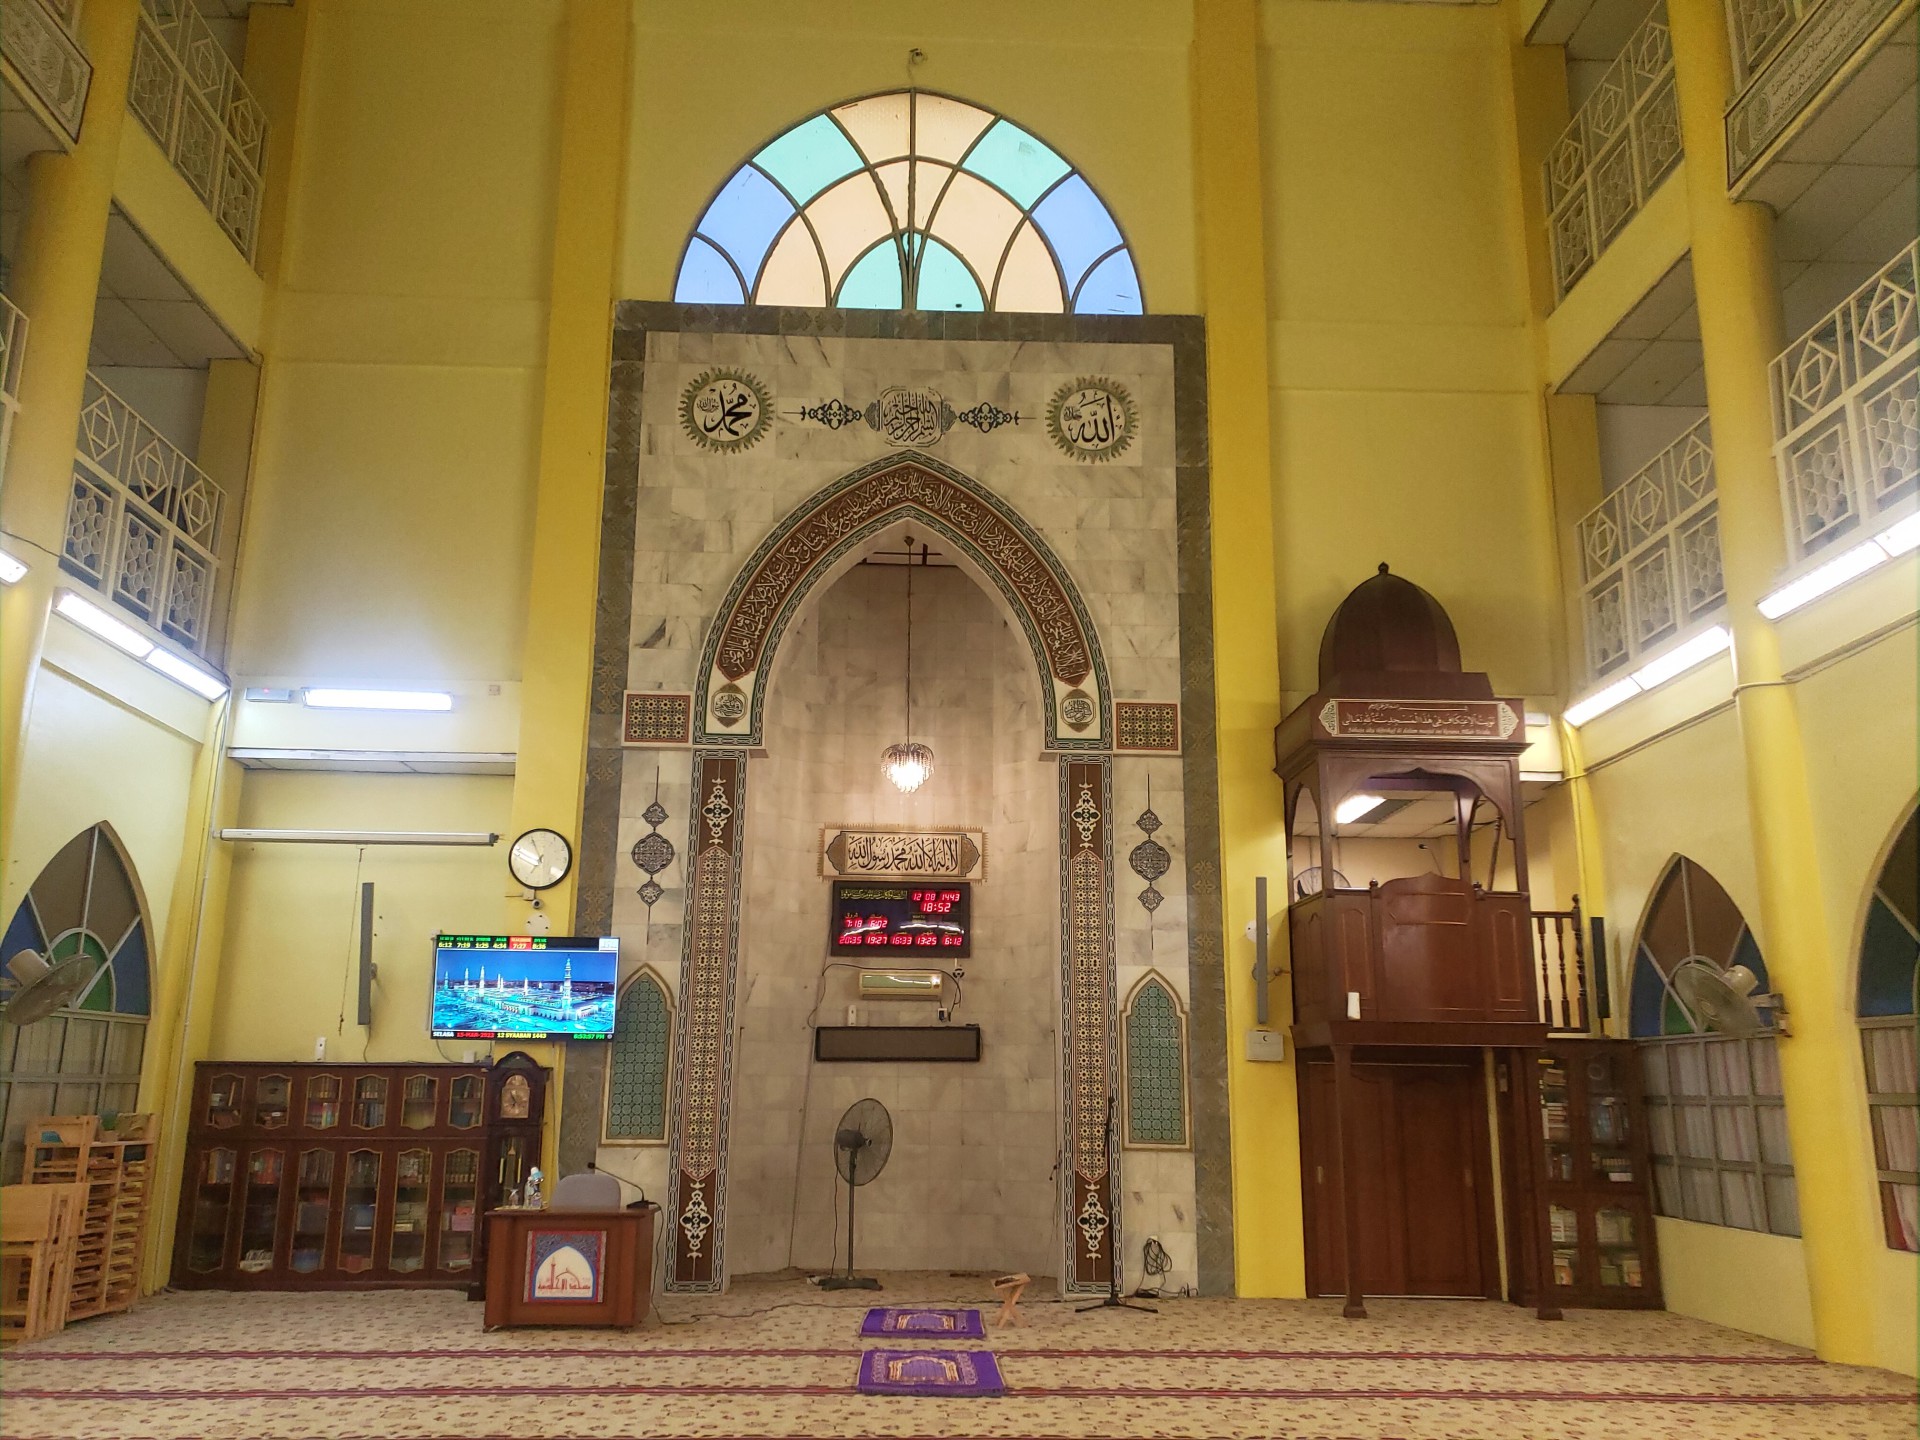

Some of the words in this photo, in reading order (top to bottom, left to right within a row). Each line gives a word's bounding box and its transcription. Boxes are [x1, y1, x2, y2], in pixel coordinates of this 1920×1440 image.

[704, 384, 756, 437] محمد
[1069, 392, 1121, 446] الله
[913, 893, 922, 901] 12
[924, 893, 936, 901] 08
[942, 893, 960, 902] 1443
[923, 902, 951, 912] 18:52
[846, 920, 863, 928] 7:18
[867, 936, 888, 944] 19:27
[917, 937, 937, 945] 13:25
